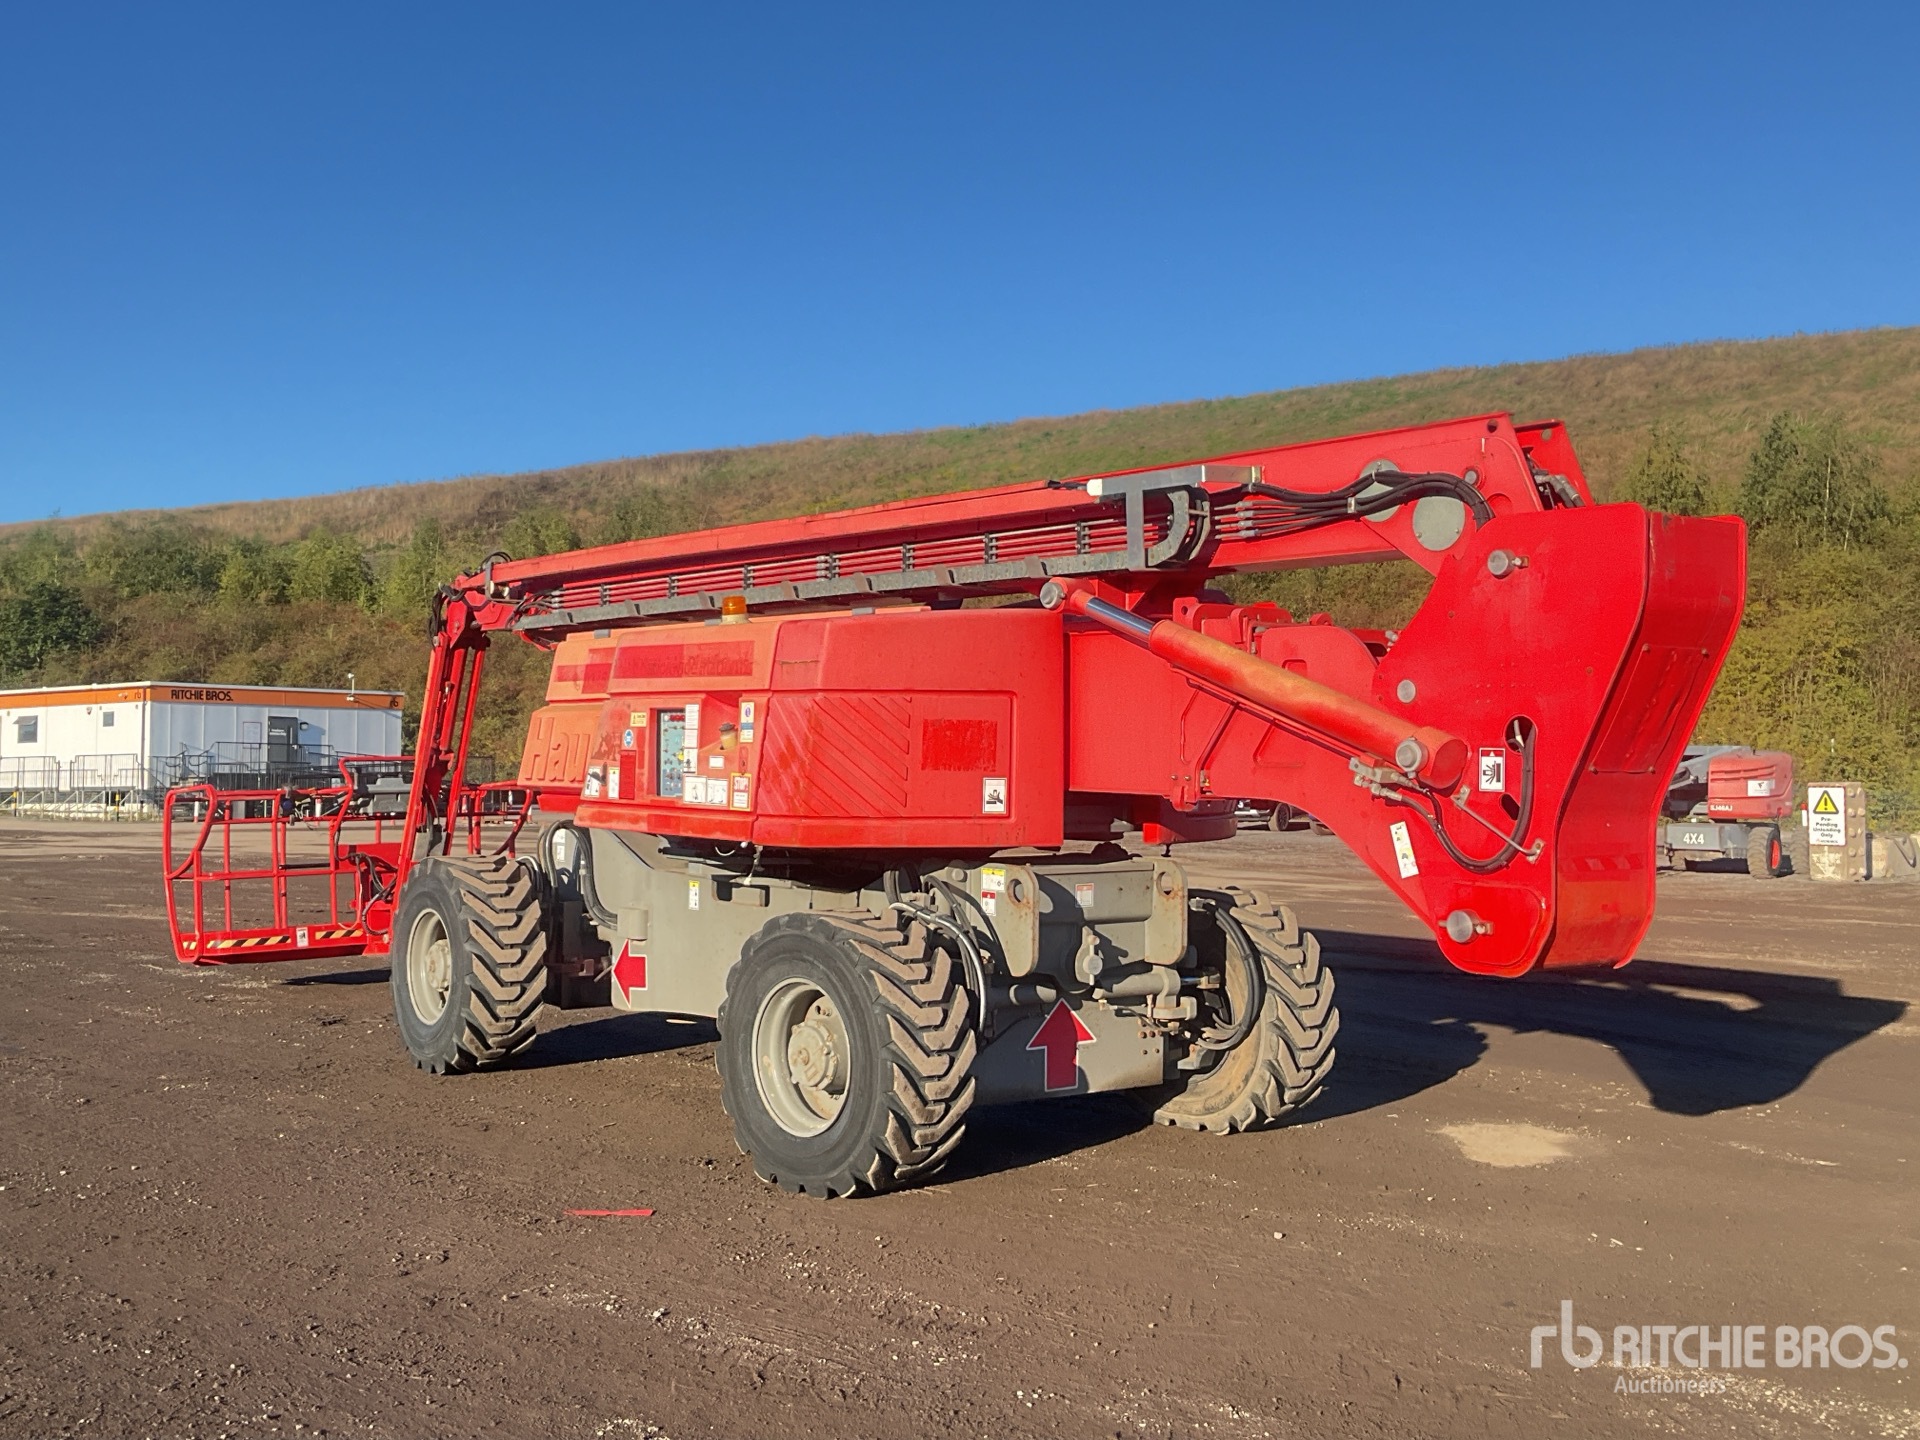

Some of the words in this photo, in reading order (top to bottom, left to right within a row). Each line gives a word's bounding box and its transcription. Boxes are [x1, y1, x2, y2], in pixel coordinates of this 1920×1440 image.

[171, 689, 204, 700] RITCHIE
[205, 691, 234, 702] BROS.
[524, 716, 592, 783] Hau
[1683, 832, 1705, 845] 4X4
